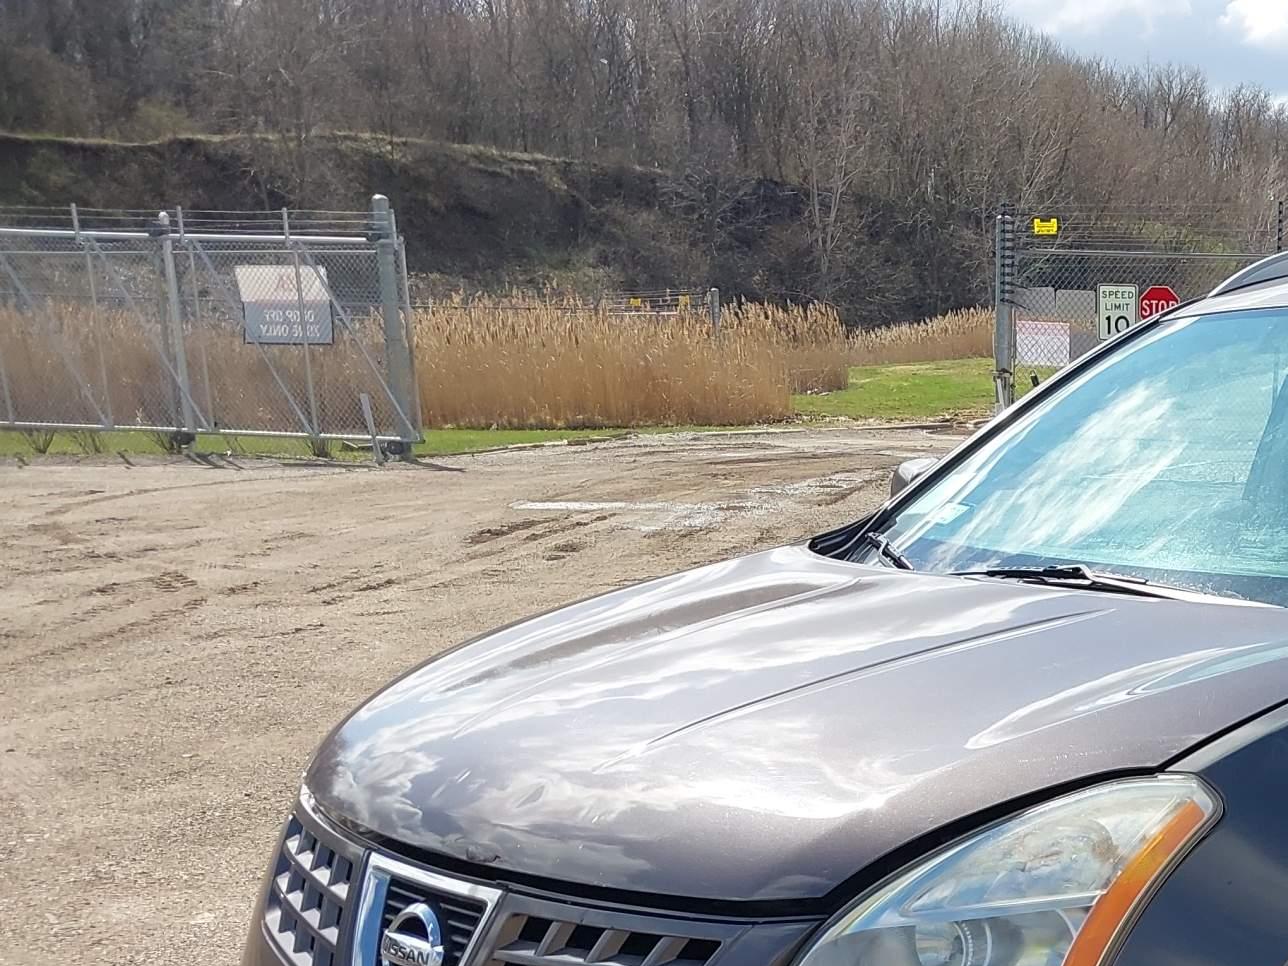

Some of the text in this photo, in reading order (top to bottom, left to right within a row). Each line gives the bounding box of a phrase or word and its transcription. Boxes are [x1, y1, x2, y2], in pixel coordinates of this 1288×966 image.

[1101, 290, 1134, 300] SPEED
[1104, 302, 1130, 311] LIMIT
[1105, 315, 1130, 335] 10
[383, 937, 430, 966] NISSAN
